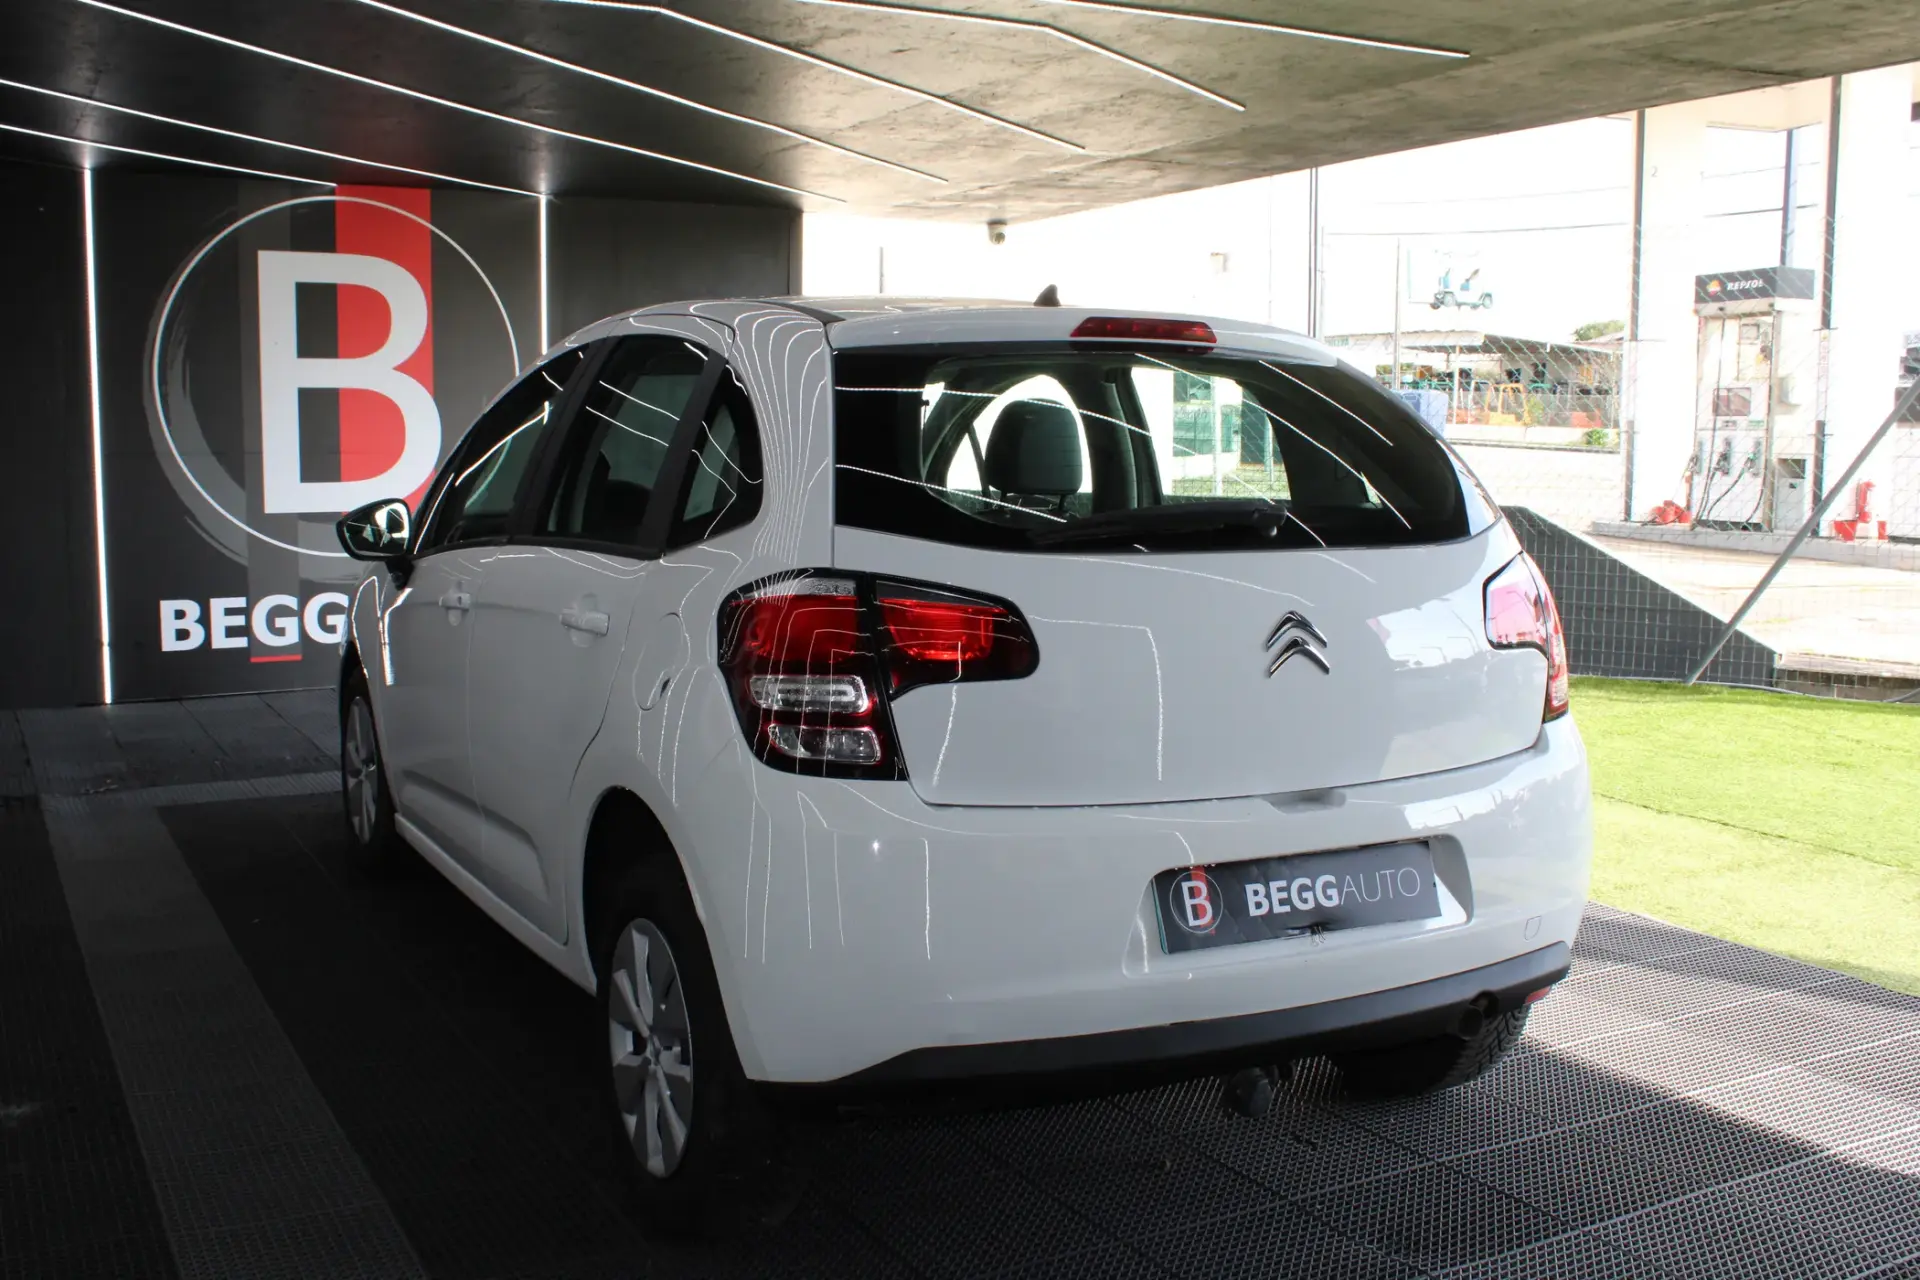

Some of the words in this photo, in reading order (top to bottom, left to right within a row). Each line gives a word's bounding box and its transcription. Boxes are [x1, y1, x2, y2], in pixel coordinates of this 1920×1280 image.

[1727, 279, 1763, 291] REPSOL
[257, 249, 442, 514] B
[159, 592, 350, 652] BEGG
[1181, 880, 1213, 927] B
[1245, 867, 1421, 917] BEGGAUTO
